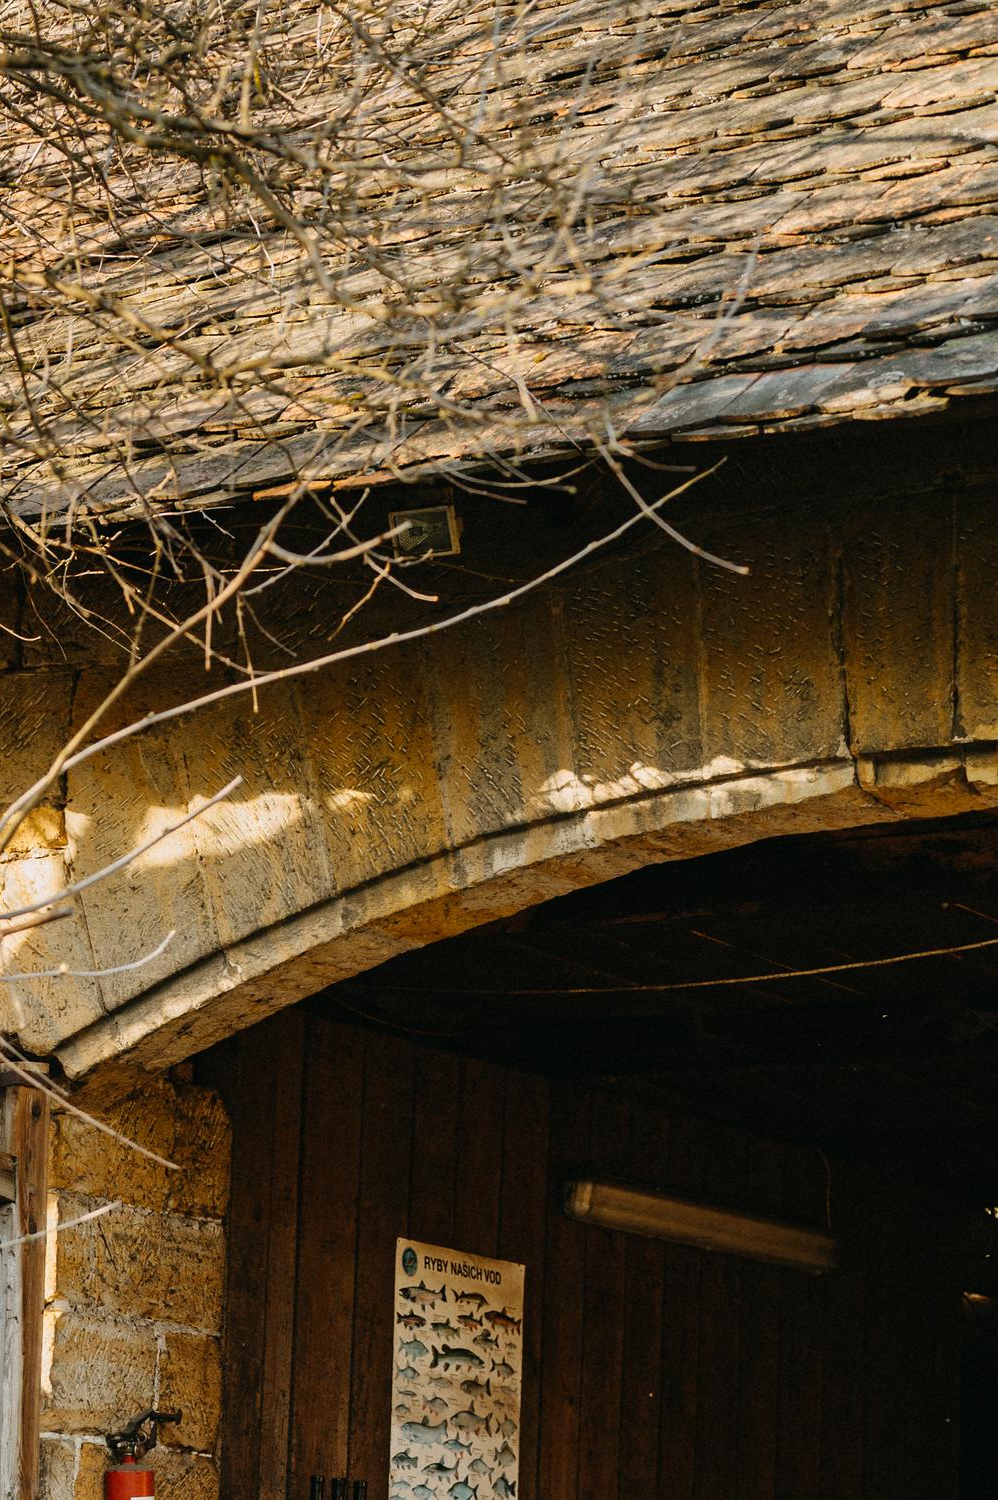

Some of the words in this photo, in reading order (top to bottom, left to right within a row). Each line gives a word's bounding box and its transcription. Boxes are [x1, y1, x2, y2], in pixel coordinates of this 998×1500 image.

[424, 1256, 448, 1272] RYBY
[450, 1261, 482, 1281] NAŠICH
[484, 1270, 501, 1285] VOD
